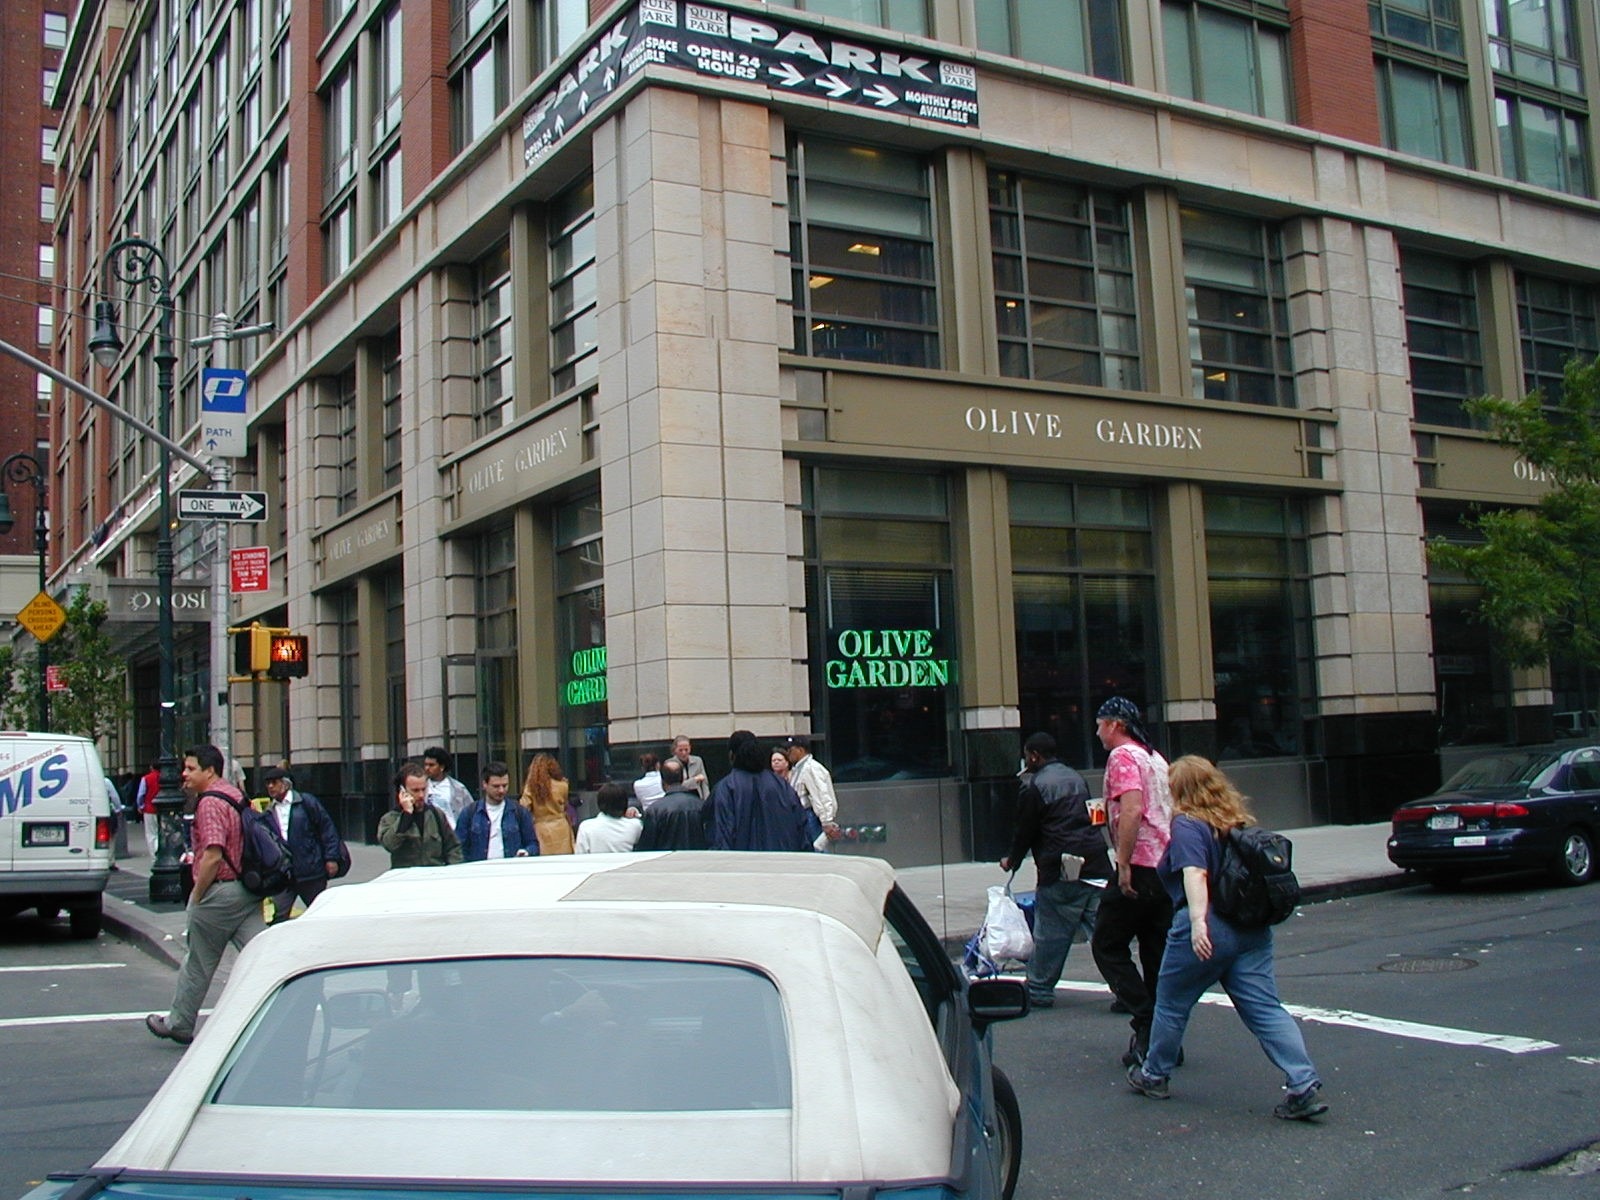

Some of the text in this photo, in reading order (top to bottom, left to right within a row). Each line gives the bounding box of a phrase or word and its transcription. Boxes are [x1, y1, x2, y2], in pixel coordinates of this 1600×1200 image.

[689, 7, 725, 22] QUIK
[690, 20, 726, 34] PARK
[646, 37, 678, 53] SPACE
[730, 16, 934, 84] PARK
[686, 44, 761, 69] OPEN 24
[538, 17, 628, 119] PARK
[697, 58, 757, 80] HOURS
[943, 64, 973, 77] QUIK
[944, 75, 974, 88] PARK
[905, 91, 977, 114] MONTHLY SPACE
[919, 105, 969, 124] AVAILABLE
[205, 428, 233, 438] PATH
[965, 407, 1203, 451] OLIVE GARDEN
[468, 427, 568, 494] OLIVE GARDEN
[190, 499, 255, 512] ONE WAY
[156, 589, 207, 609] osí
[838, 629, 934, 658] OLIVE
[826, 659, 949, 689] GARDEN
